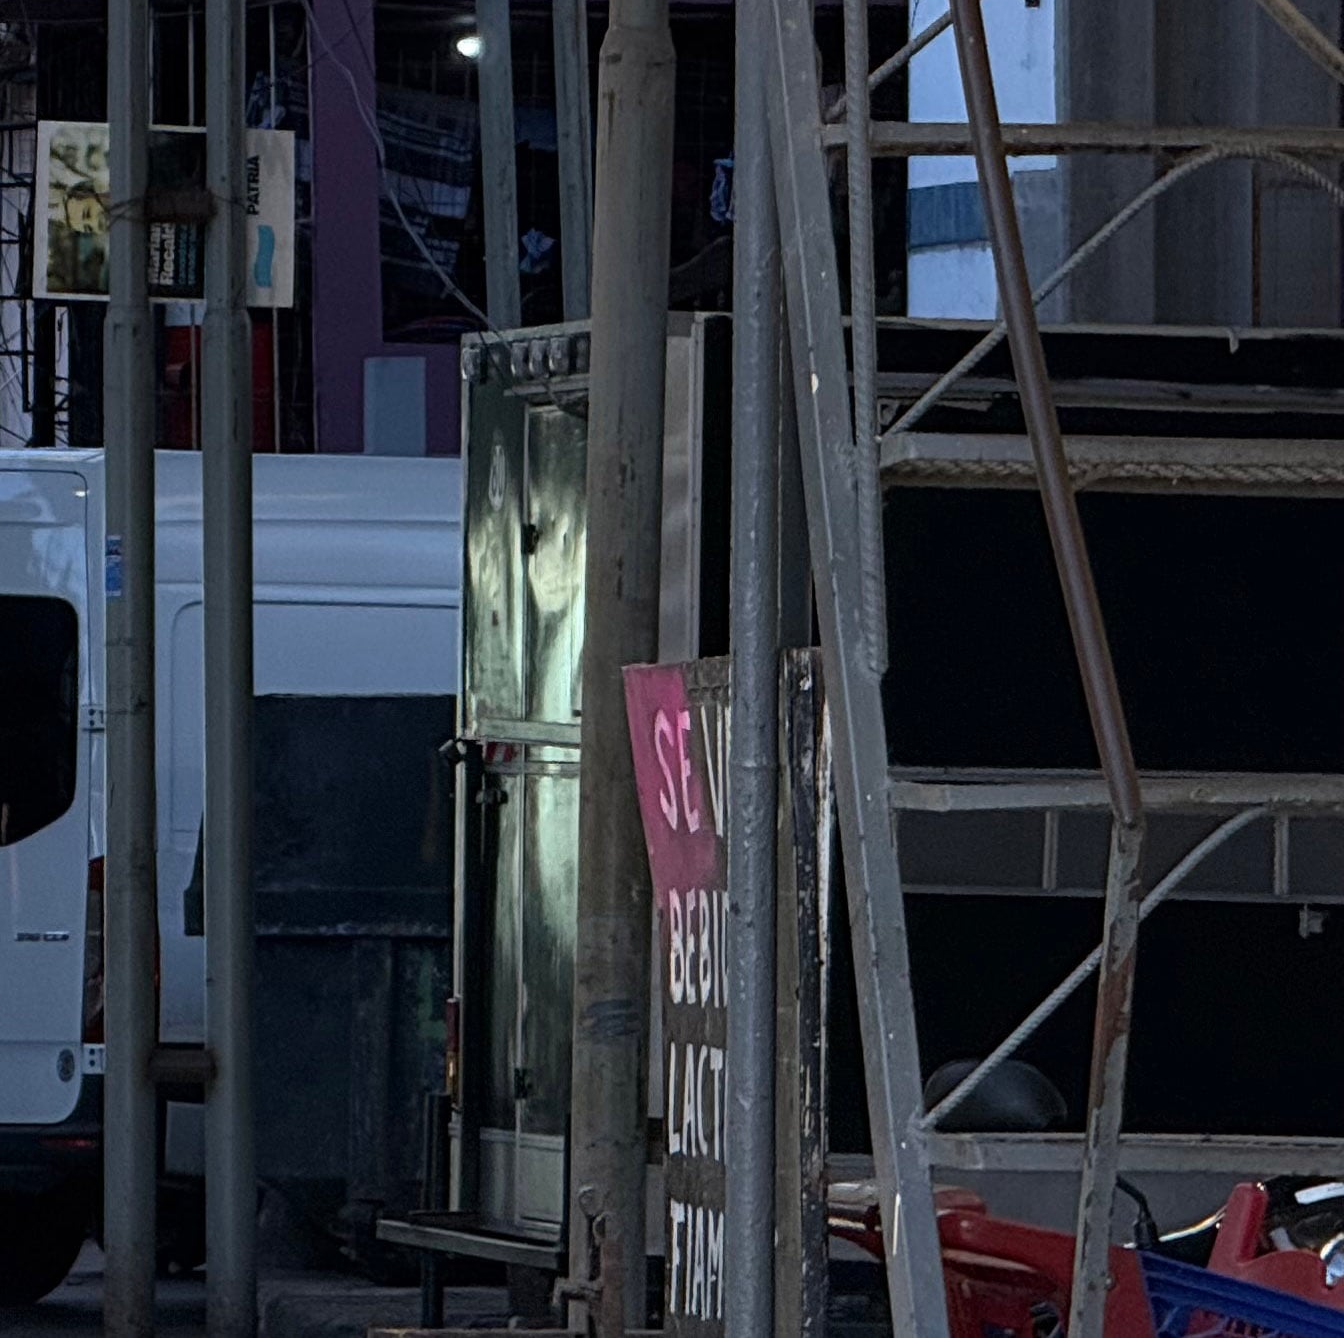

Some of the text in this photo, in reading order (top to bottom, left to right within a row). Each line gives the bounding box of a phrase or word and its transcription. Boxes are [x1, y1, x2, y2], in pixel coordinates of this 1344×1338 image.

[246, 155, 260, 216] PATRIA
[654, 700, 732, 838] SE V
[668, 1040, 729, 1168] LACT
